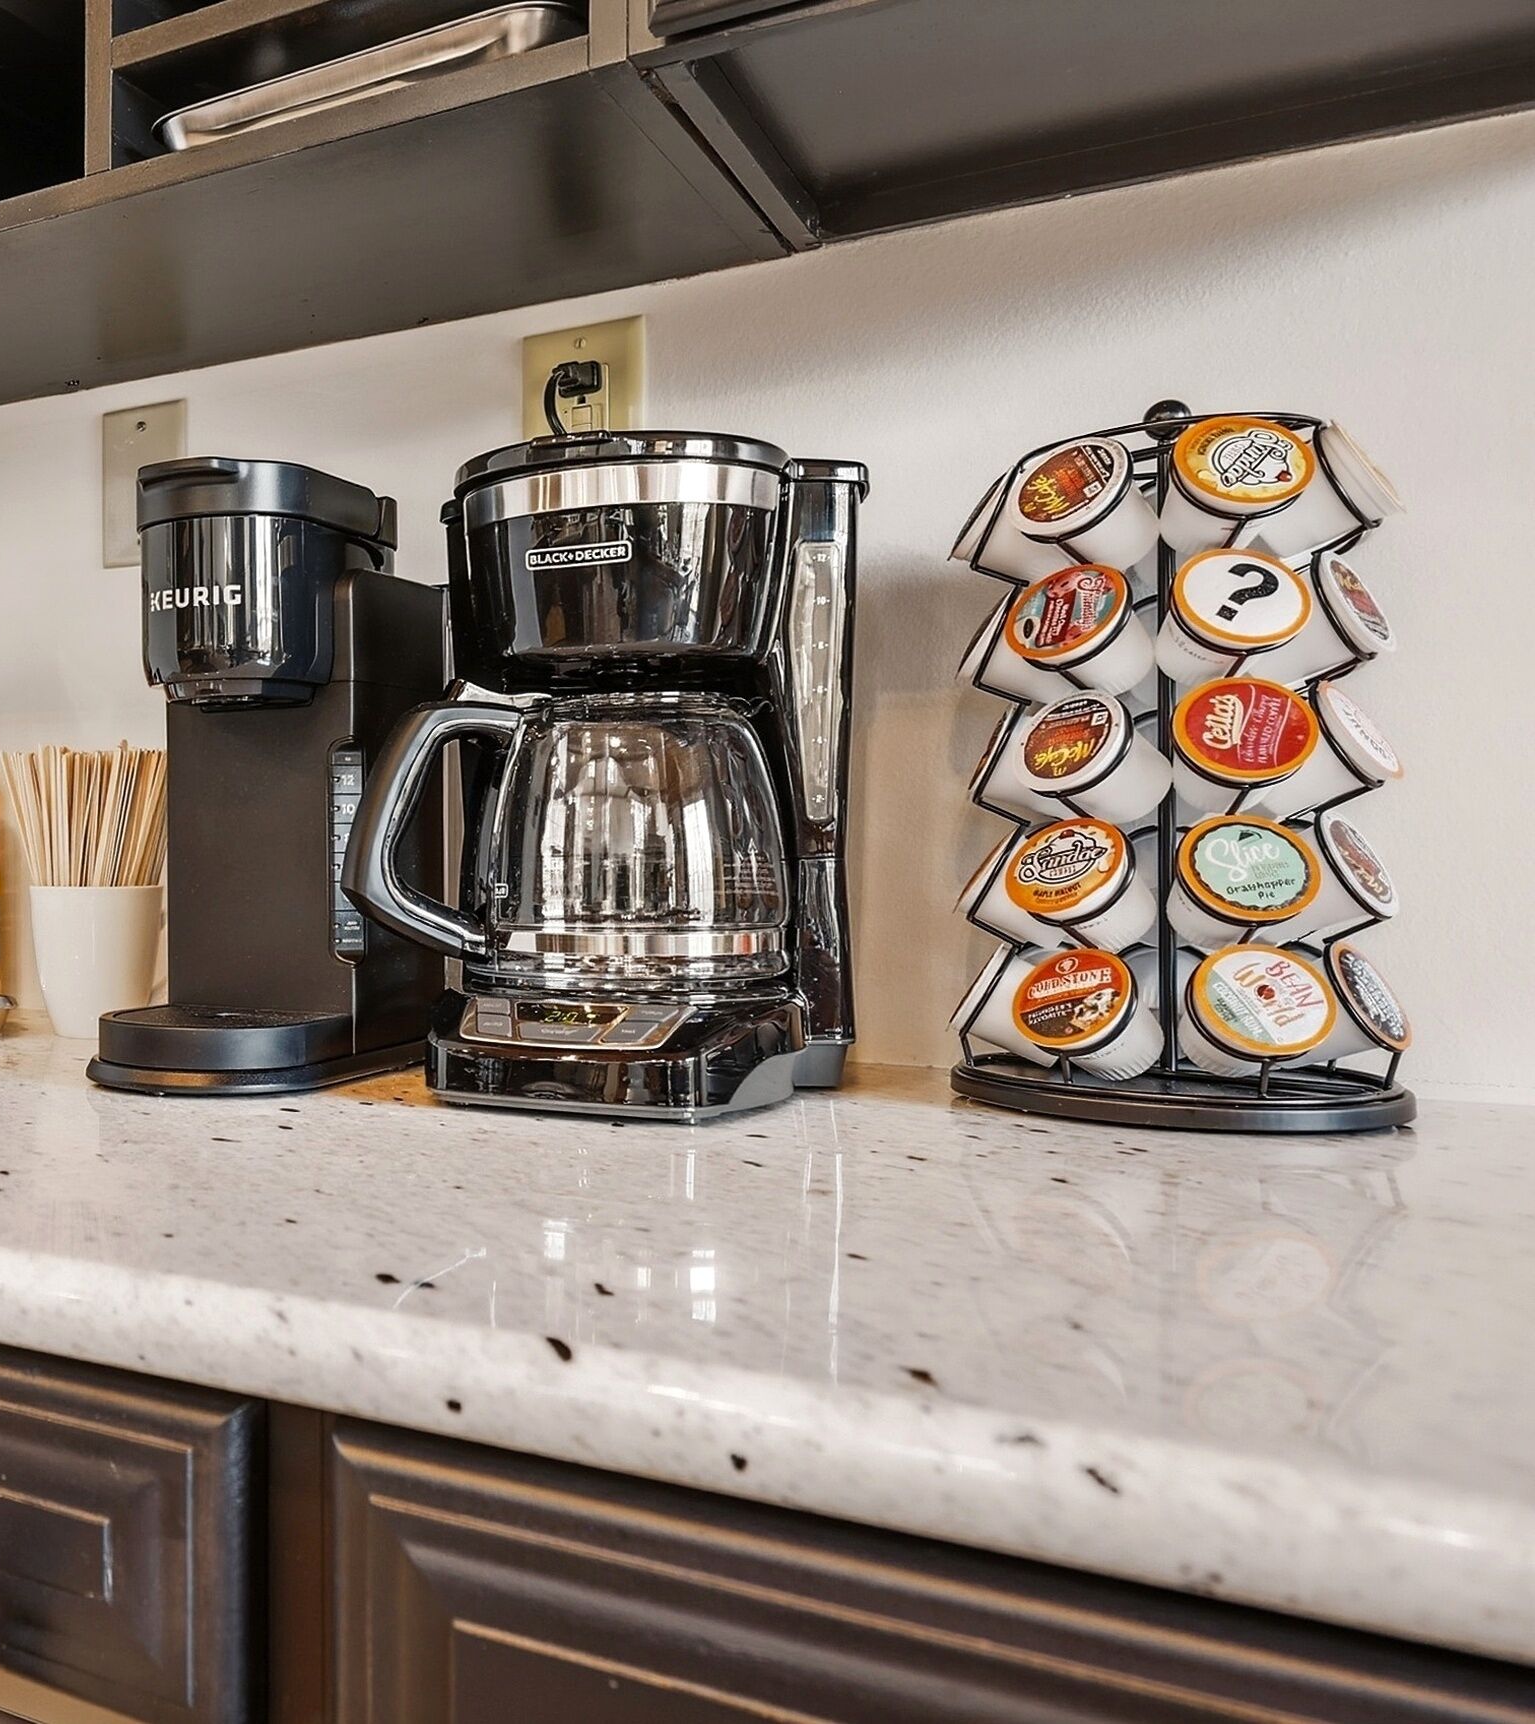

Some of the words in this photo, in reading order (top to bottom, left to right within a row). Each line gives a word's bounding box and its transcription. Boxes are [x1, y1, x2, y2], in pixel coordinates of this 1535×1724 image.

[150, 584, 242, 612] KEURIG
[1202, 693, 1244, 750] Cella's
[341, 774, 355, 786] 12
[341, 803, 356, 815] 10
[1019, 840, 1109, 883] Sundae
[1205, 837, 1280, 882] Slice
[1225, 877, 1296, 896] Grasshopper
[1258, 889, 1276, 900] Pie
[1265, 960, 1325, 1009] BEAN
